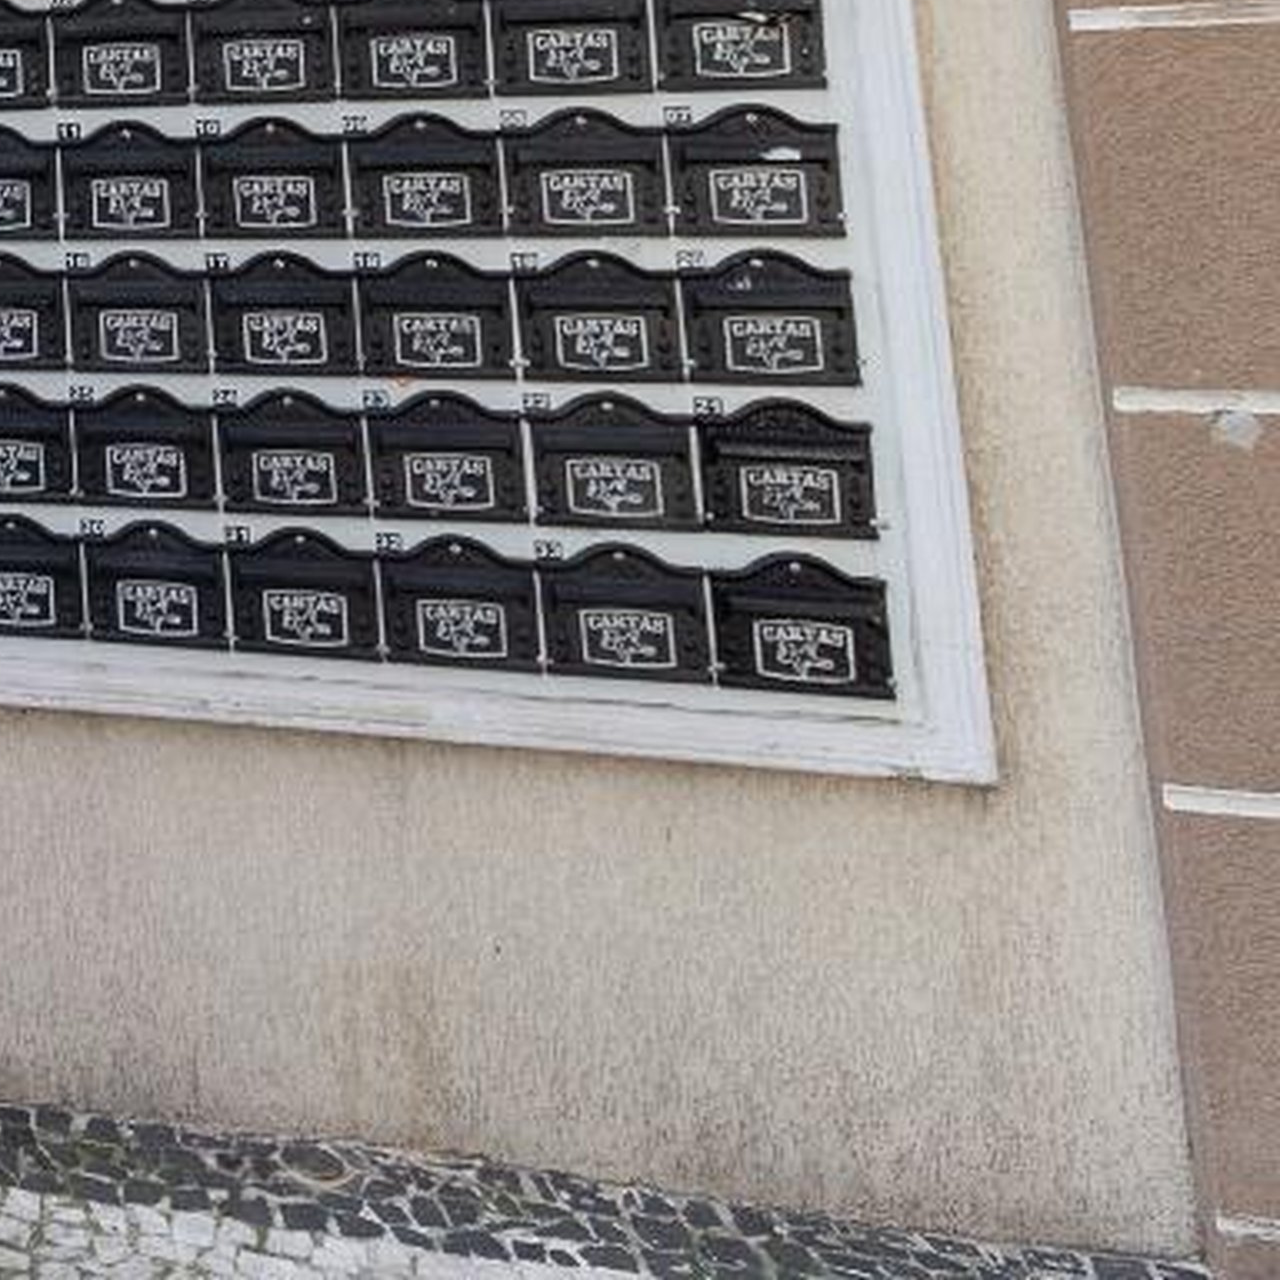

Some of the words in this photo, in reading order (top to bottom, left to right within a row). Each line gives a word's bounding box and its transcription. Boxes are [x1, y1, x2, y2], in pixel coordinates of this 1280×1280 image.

[536, 34, 608, 50] CARTAS
[702, 26, 779, 43] CARTAS
[89, 49, 152, 64] CARTAS
[230, 44, 298, 61] CARTAS
[378, 41, 448, 57] CARTAS
[240, 181, 308, 197] CARTAS
[389, 177, 461, 193] CARTAS
[549, 175, 624, 191] CARTAS
[718, 173, 798, 190] CARTAS
[98, 183, 162, 197] CARTAS
[106, 316, 171, 330] CARTAS
[248, 317, 317, 331] CARTAS
[400, 320, 472, 333] CARTAS
[564, 320, 640, 335] CARTAS
[731, 320, 811, 337] CARTAS
[112, 448, 177, 464] CARTAS
[259, 455, 328, 471] CARTAS
[412, 459, 484, 474] CARTAS
[572, 462, 652, 480] CARTAS
[748, 471, 829, 490] CARTAS
[124, 587, 190, 604] CARTAS
[269, 596, 339, 611] CARTAS
[424, 606, 496, 623] CARTAS
[588, 615, 664, 631] CARTAS
[763, 626, 844, 646] CARTAS
